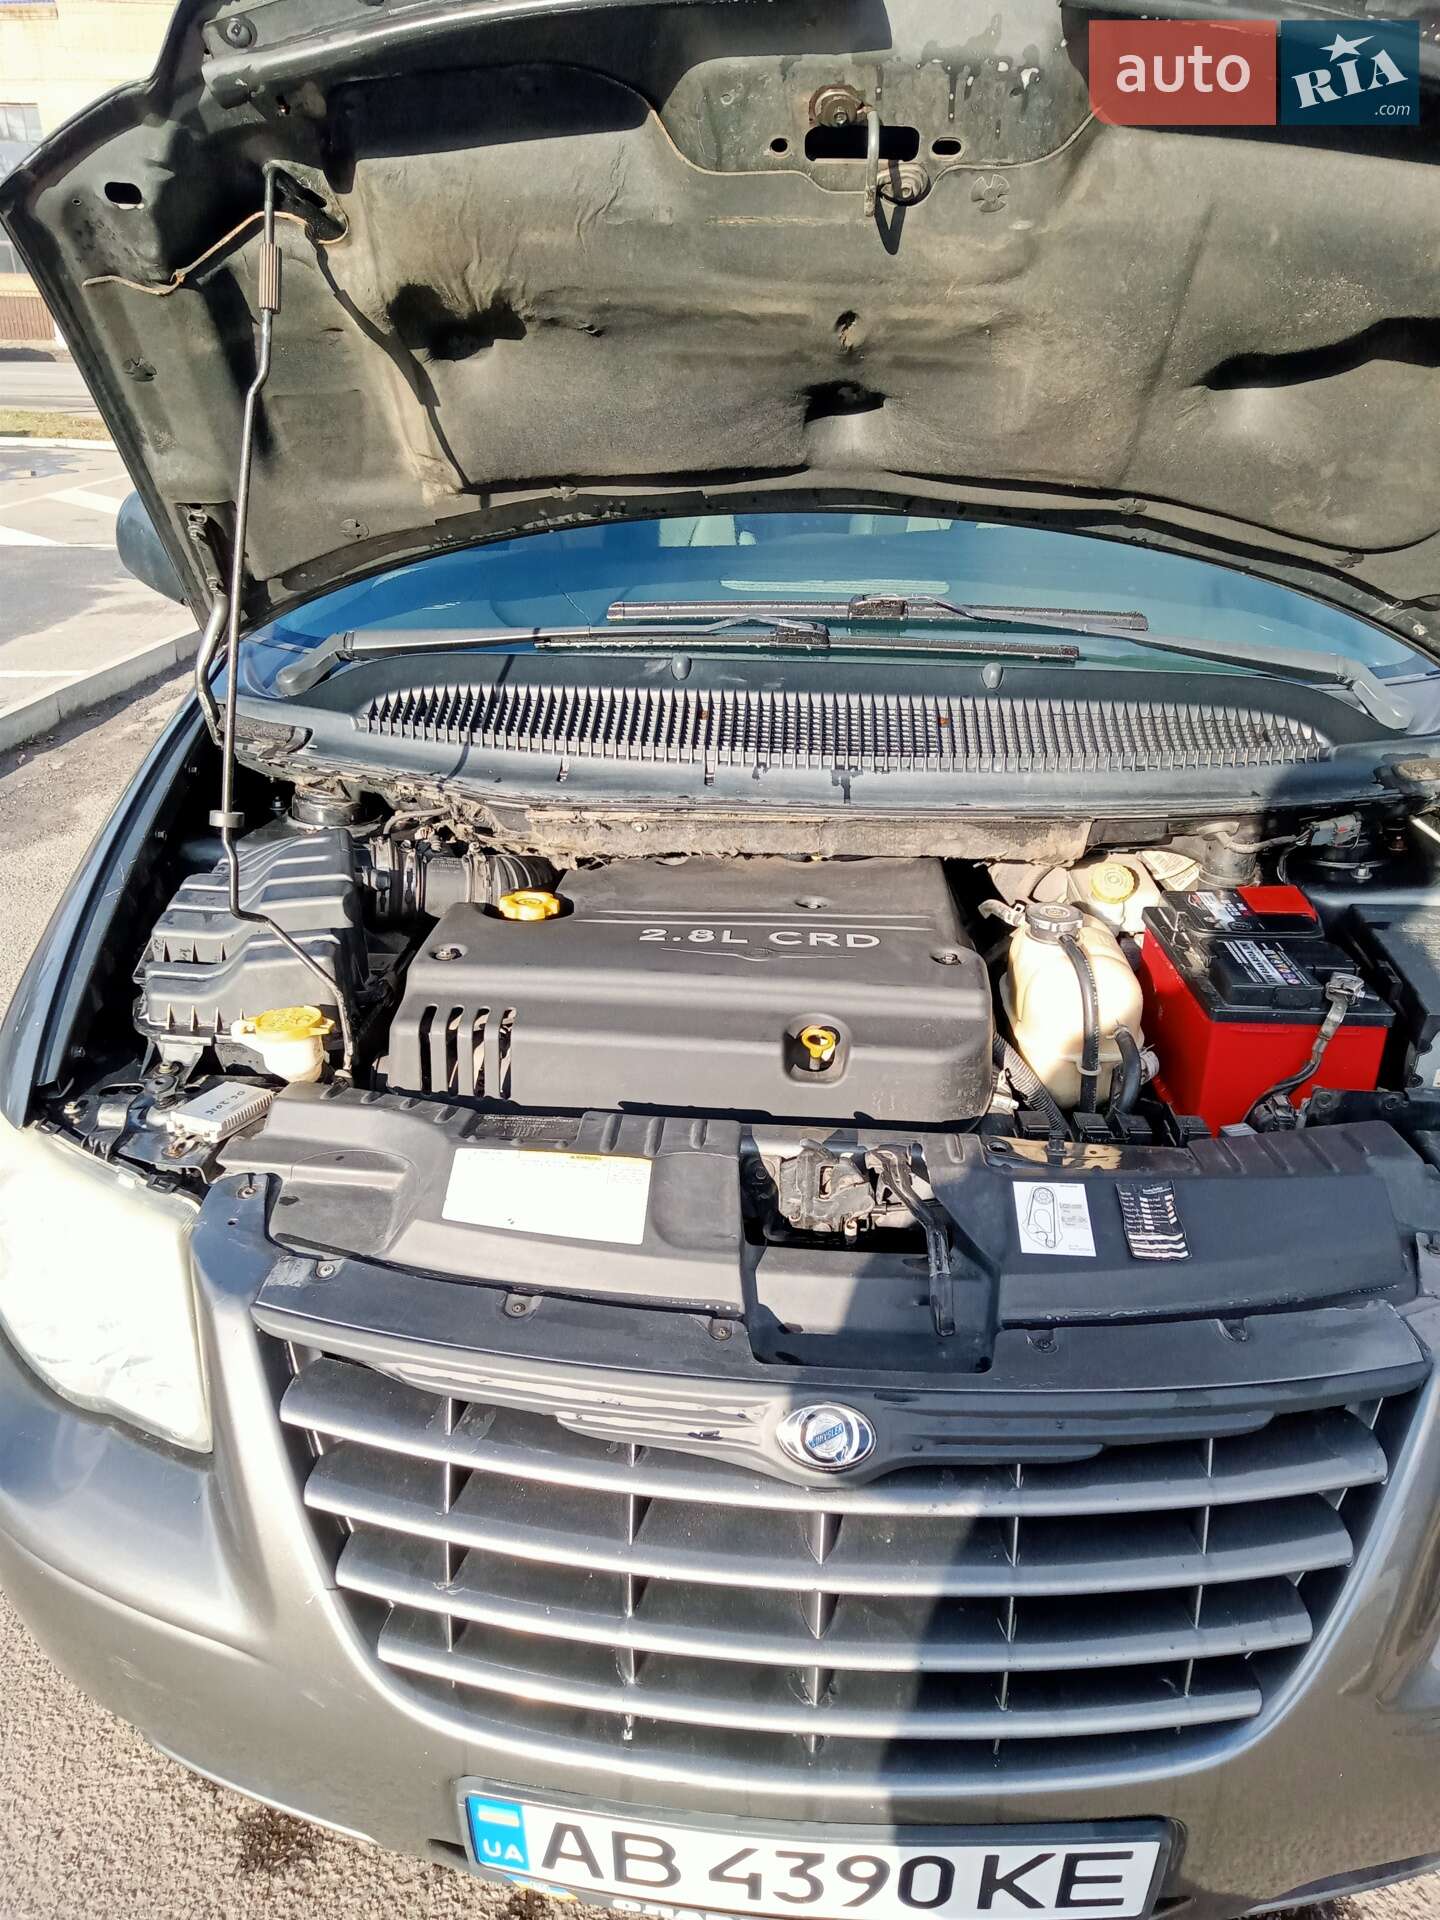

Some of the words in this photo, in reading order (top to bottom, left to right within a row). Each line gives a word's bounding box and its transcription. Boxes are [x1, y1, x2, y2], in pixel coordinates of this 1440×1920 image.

[639, 928, 748, 944] 2.8L
[768, 931, 880, 948] CRD
[483, 1838, 524, 1864] UA
[708, 1847, 955, 1909] 4390
